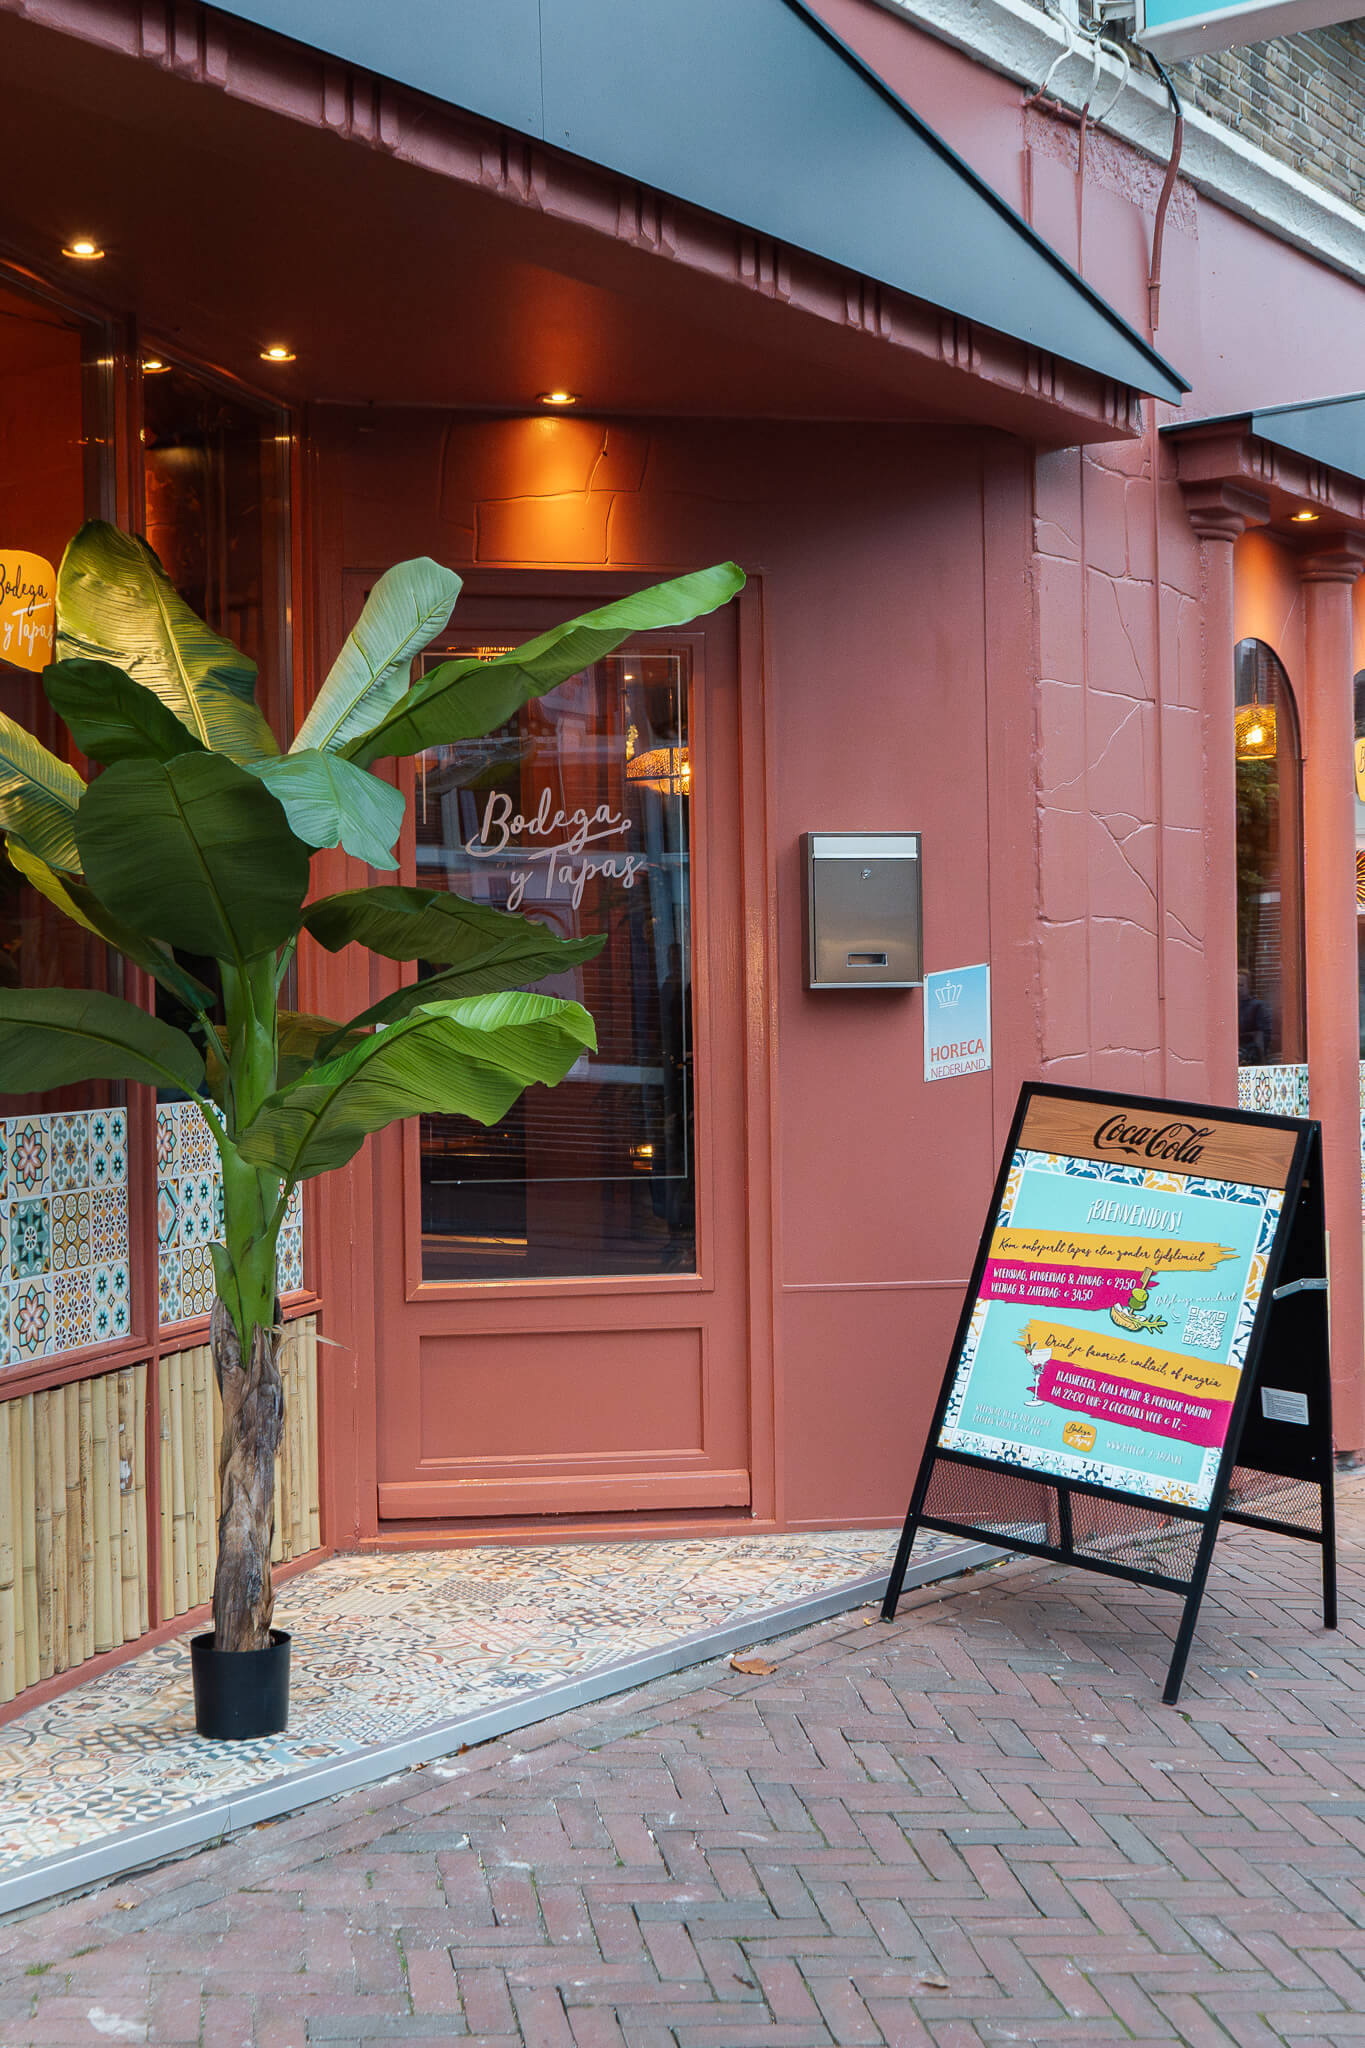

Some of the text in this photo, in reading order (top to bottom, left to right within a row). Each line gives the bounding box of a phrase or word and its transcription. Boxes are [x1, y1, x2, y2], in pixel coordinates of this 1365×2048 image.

[3, 621, 14, 651] y
[465, 787, 622, 857] Bodega
[507, 819, 645, 911] y Tapas
[930, 1038, 985, 1063] HORECA
[930, 1058, 986, 1079] NEDERLAND
[1087, 1199, 1183, 1234] ¡BIENVENIDOS!
[998, 1237, 1206, 1266] Kom onbeperkt tapas eten zonder tijdslimiet
[991, 1281, 1017, 1295] VRIJDAG
[1018, 1284, 1025, 1296] &
[1026, 1285, 1062, 1299] ZATERDAG:
[1029, 1270, 1067, 1285] DONDERDAG
[1069, 1272, 1075, 1285] &
[1045, 1333, 1073, 1350] Drink
[1067, 1344, 1085, 1357] je
[1086, 1344, 1128, 1363] favoriete
[1170, 1367, 1184, 1380] of
[1182, 1373, 1222, 1390] sangria
[1051, 1385, 1062, 1398] NA
[1062, 1388, 1086, 1404] 22:00
[1102, 1398, 1110, 1410] 2
[1108, 1401, 1145, 1420] COCKTAILS
[1145, 1410, 1164, 1425] VOOR
[1098, 1381, 1119, 1396] ZOALS
[1119, 1386, 1142, 1402] MOJITO
[1142, 1392, 1151, 1405] &
[1150, 1395, 1184, 1413] PORNSTAR
[1184, 1402, 1213, 1420] MARTINI
